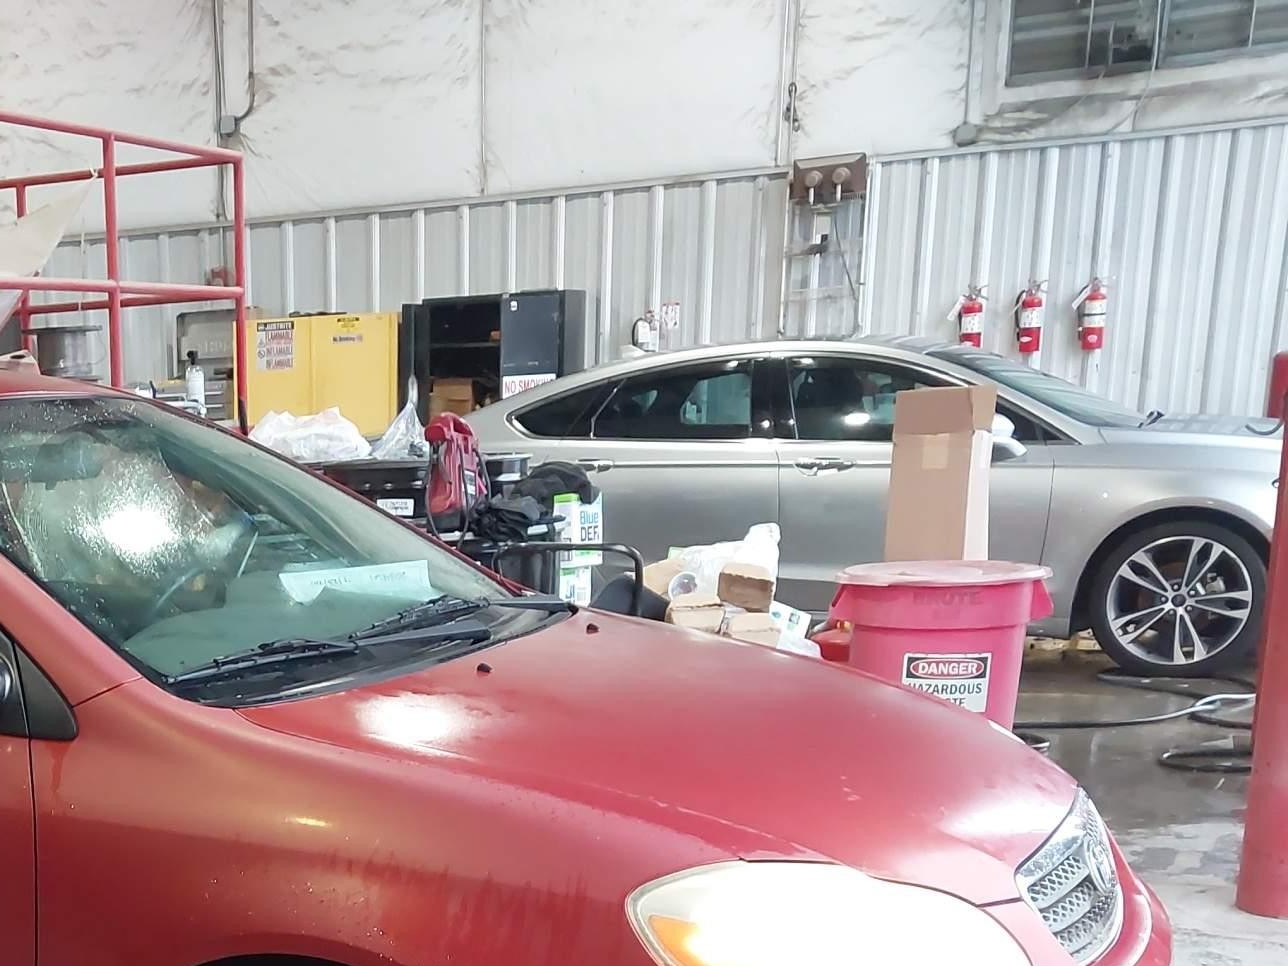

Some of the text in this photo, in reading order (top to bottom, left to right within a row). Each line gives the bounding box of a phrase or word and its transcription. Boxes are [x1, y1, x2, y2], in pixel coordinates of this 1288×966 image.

[505, 380, 516, 395] NO
[580, 510, 599, 525] Blue
[918, 662, 978, 675] DANGER
